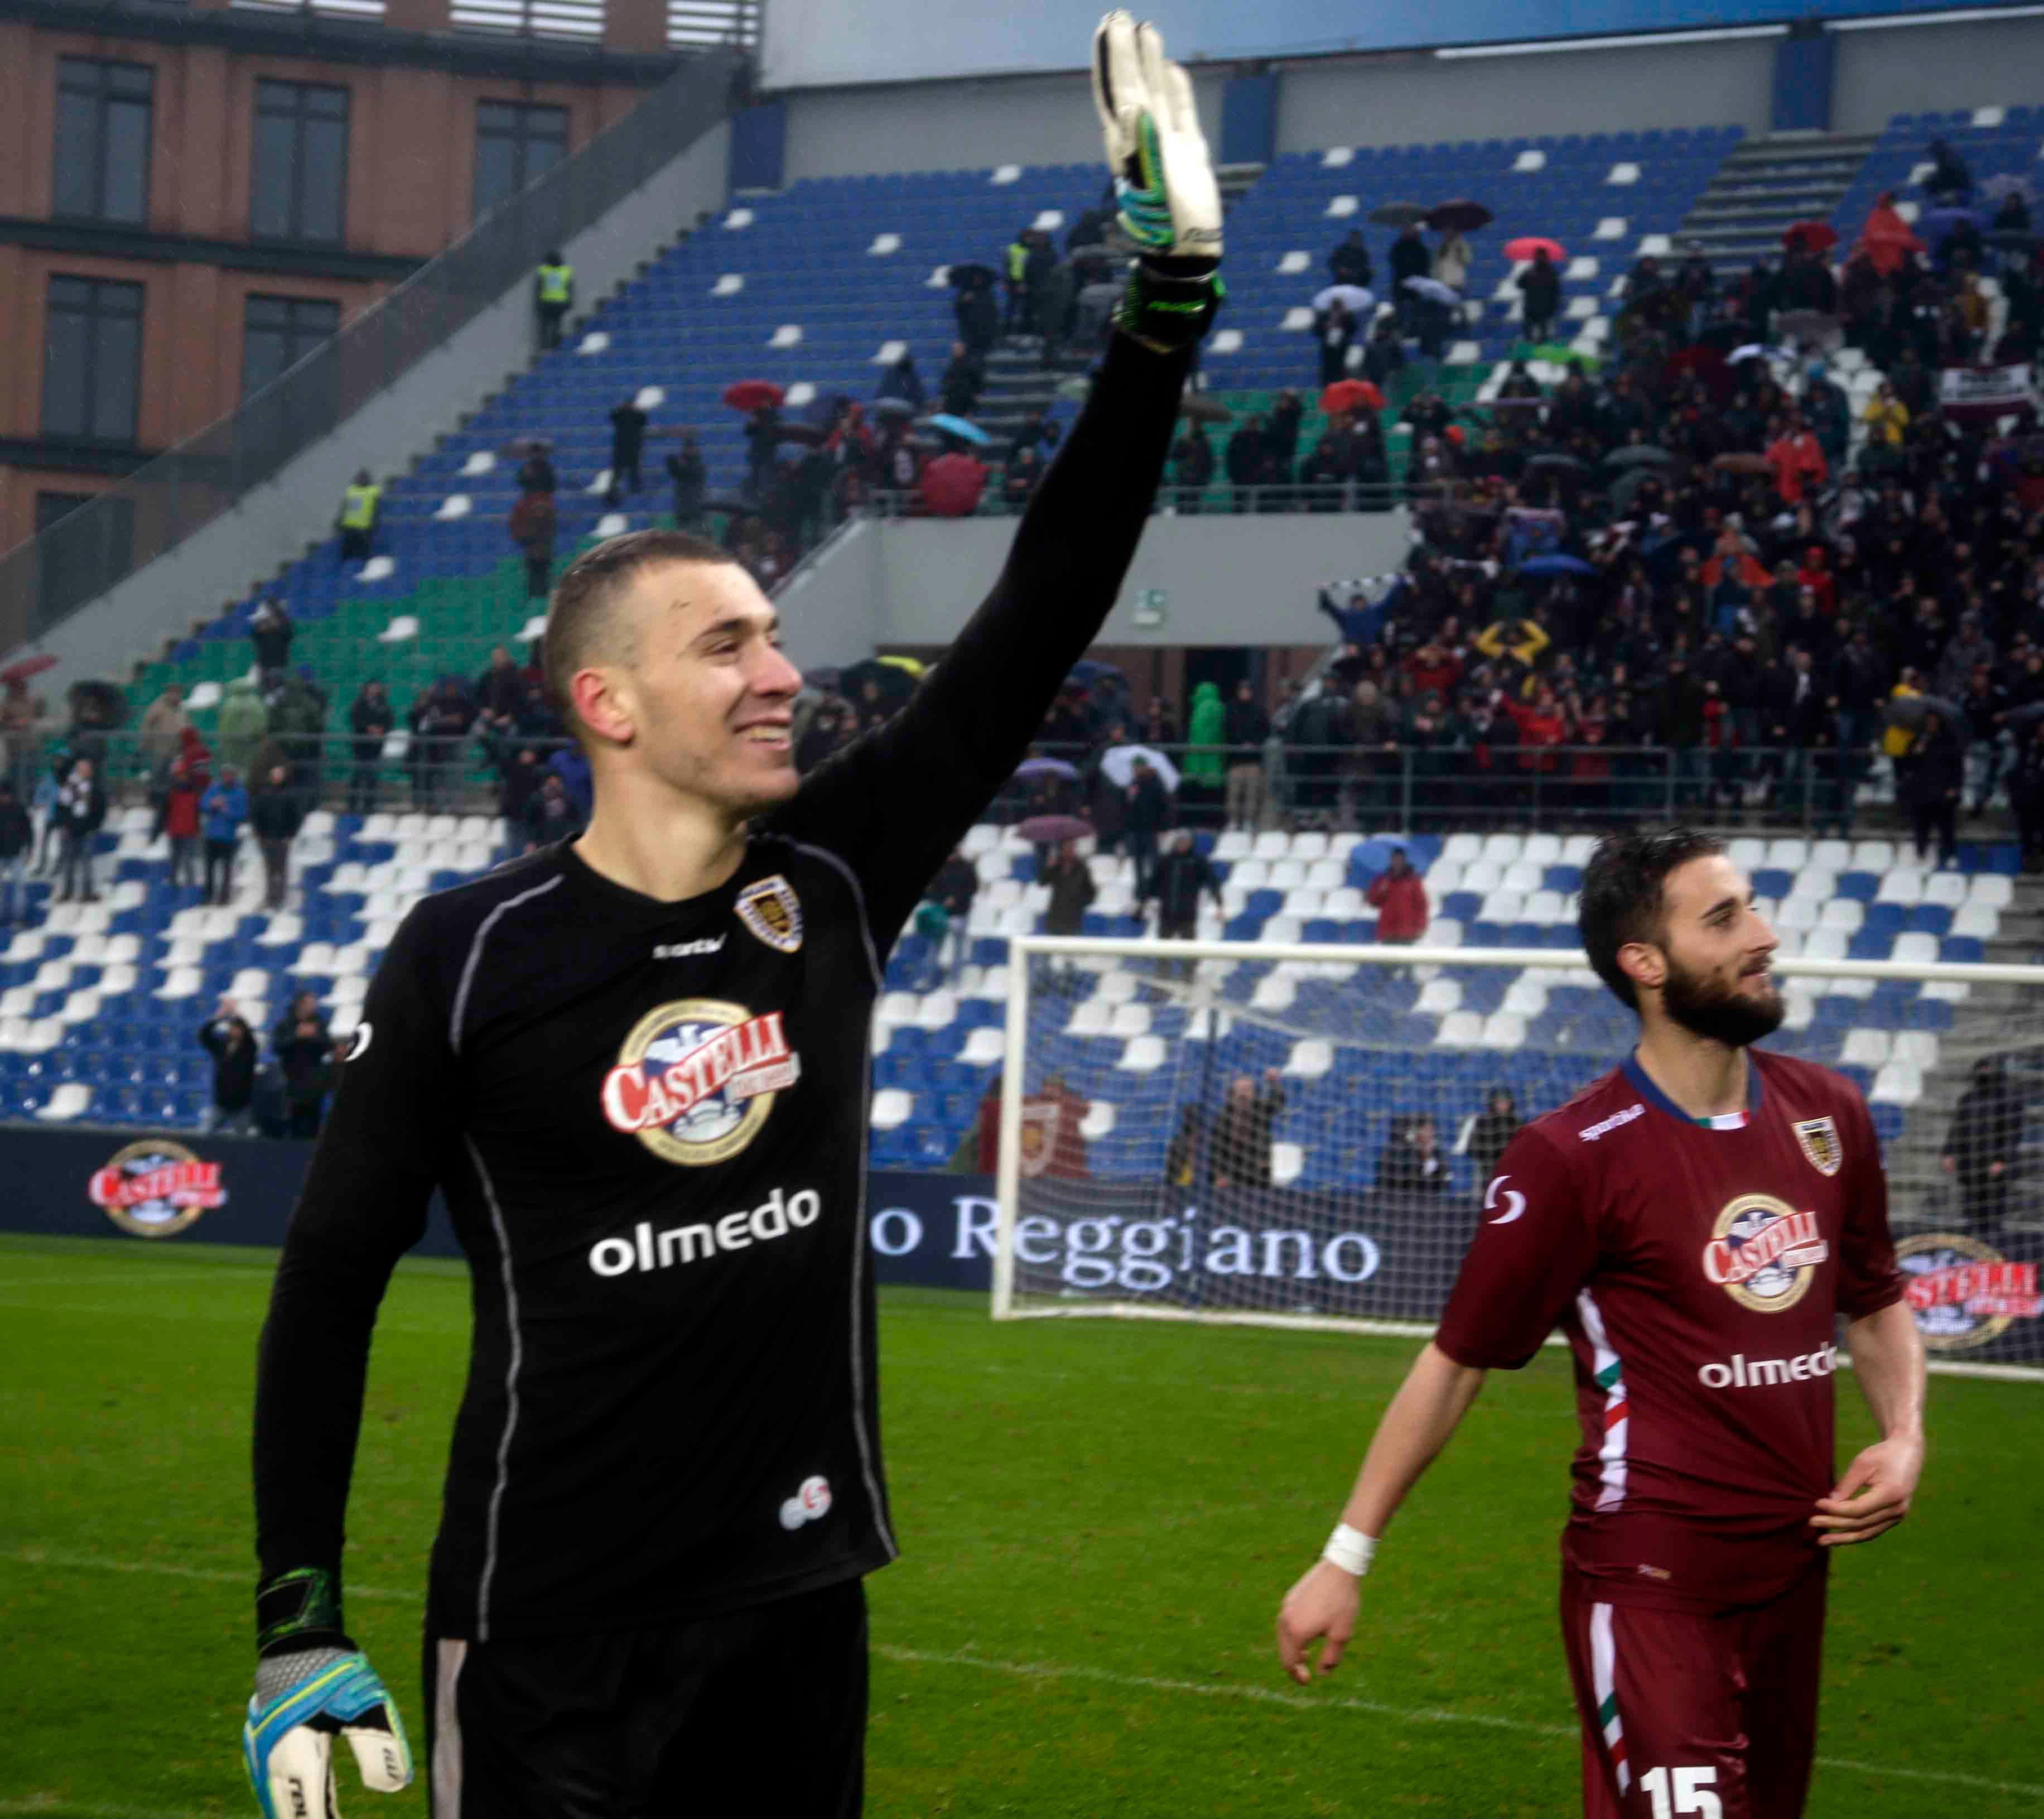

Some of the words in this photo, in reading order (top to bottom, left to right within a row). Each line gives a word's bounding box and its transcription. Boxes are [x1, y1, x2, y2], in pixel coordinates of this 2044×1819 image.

[602, 1011, 788, 1130] CASTELLI
[589, 1187, 821, 1277] olmedo
[951, 1196, 1381, 1291] Reggiano
[1702, 1211, 1820, 1284] CASTELLI
[1640, 1765, 1723, 1819] 15
